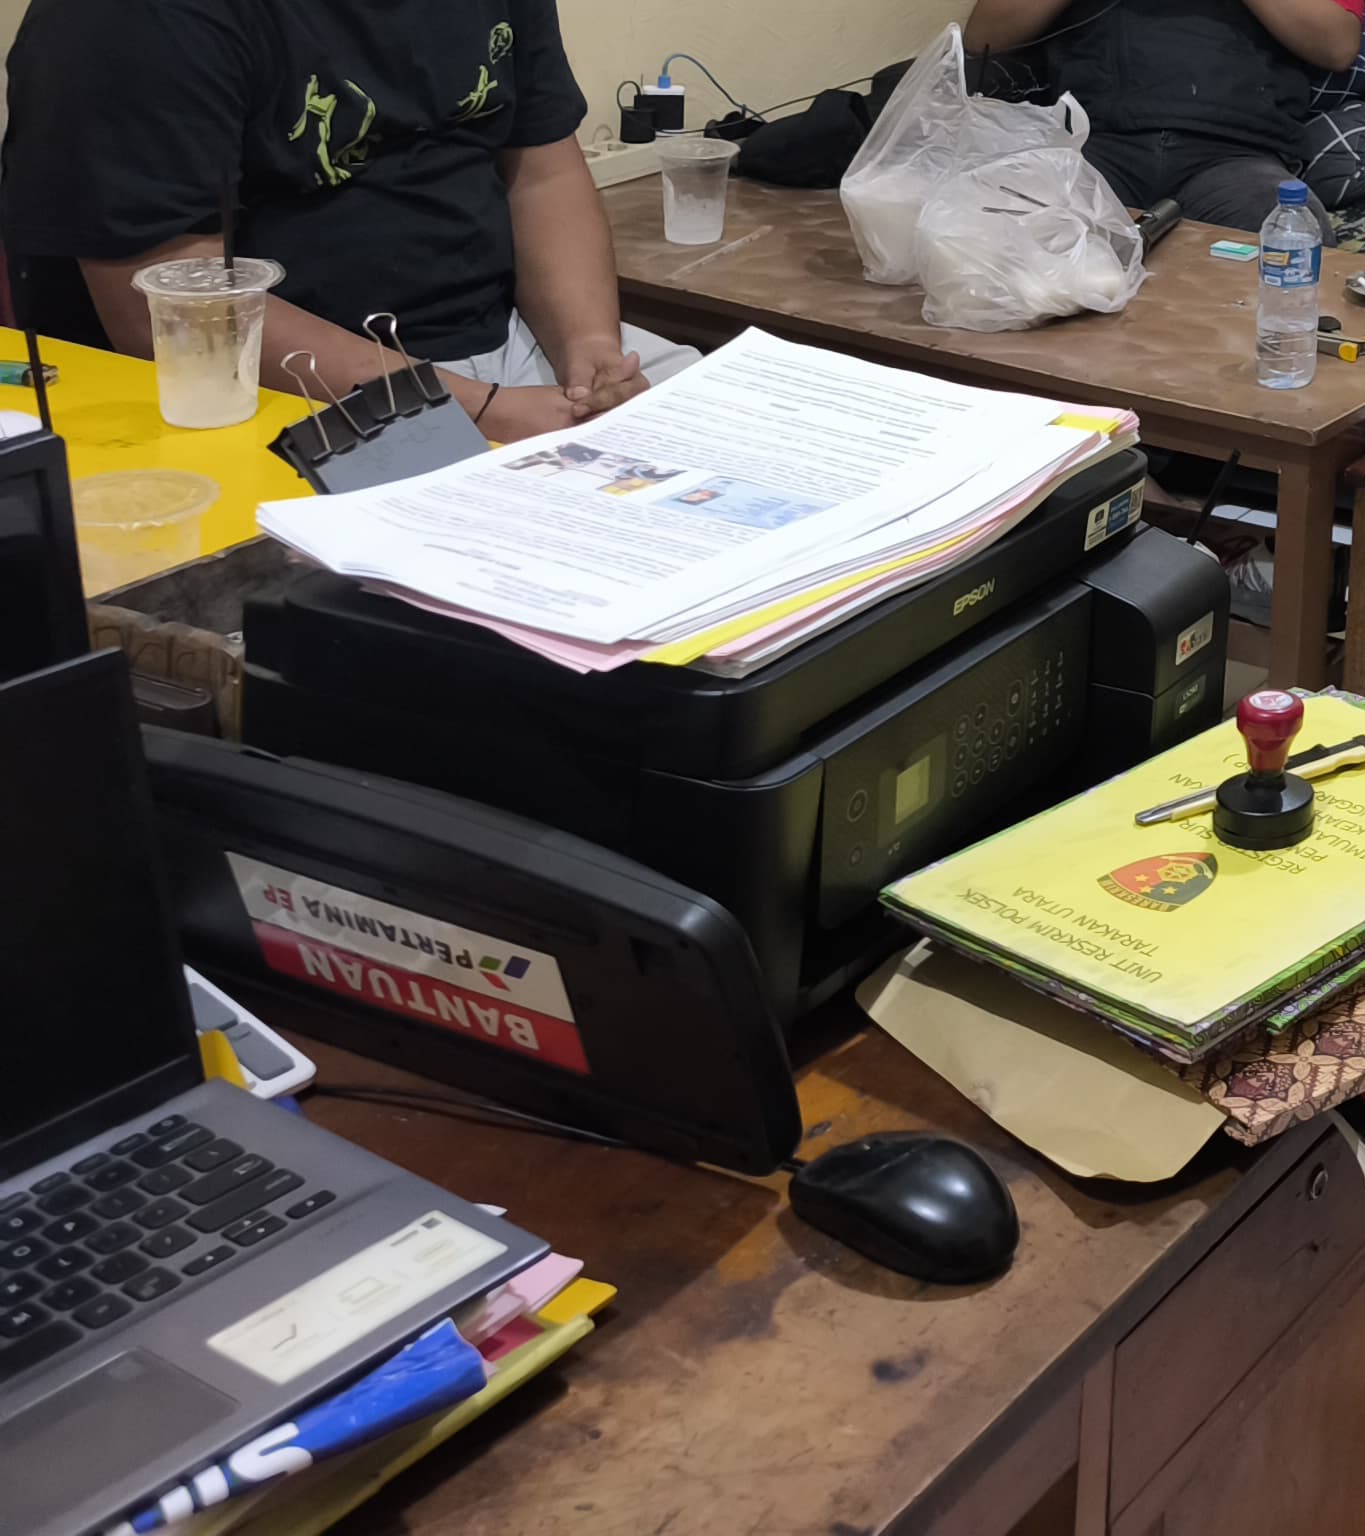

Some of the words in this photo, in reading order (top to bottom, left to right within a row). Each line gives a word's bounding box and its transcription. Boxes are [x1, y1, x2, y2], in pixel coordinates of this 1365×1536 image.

[953, 577, 996, 616] EPSON
[263, 882, 295, 913] EP
[956, 887, 1032, 926] POLSEK
[1012, 885, 1075, 920] UTARA
[302, 895, 475, 970] PERTAMINA
[1027, 920, 1111, 962] RESKRIM
[1071, 913, 1160, 957] TARAKAN
[1108, 957, 1164, 984] UNIT
[297, 941, 541, 1052] BANTUAN
